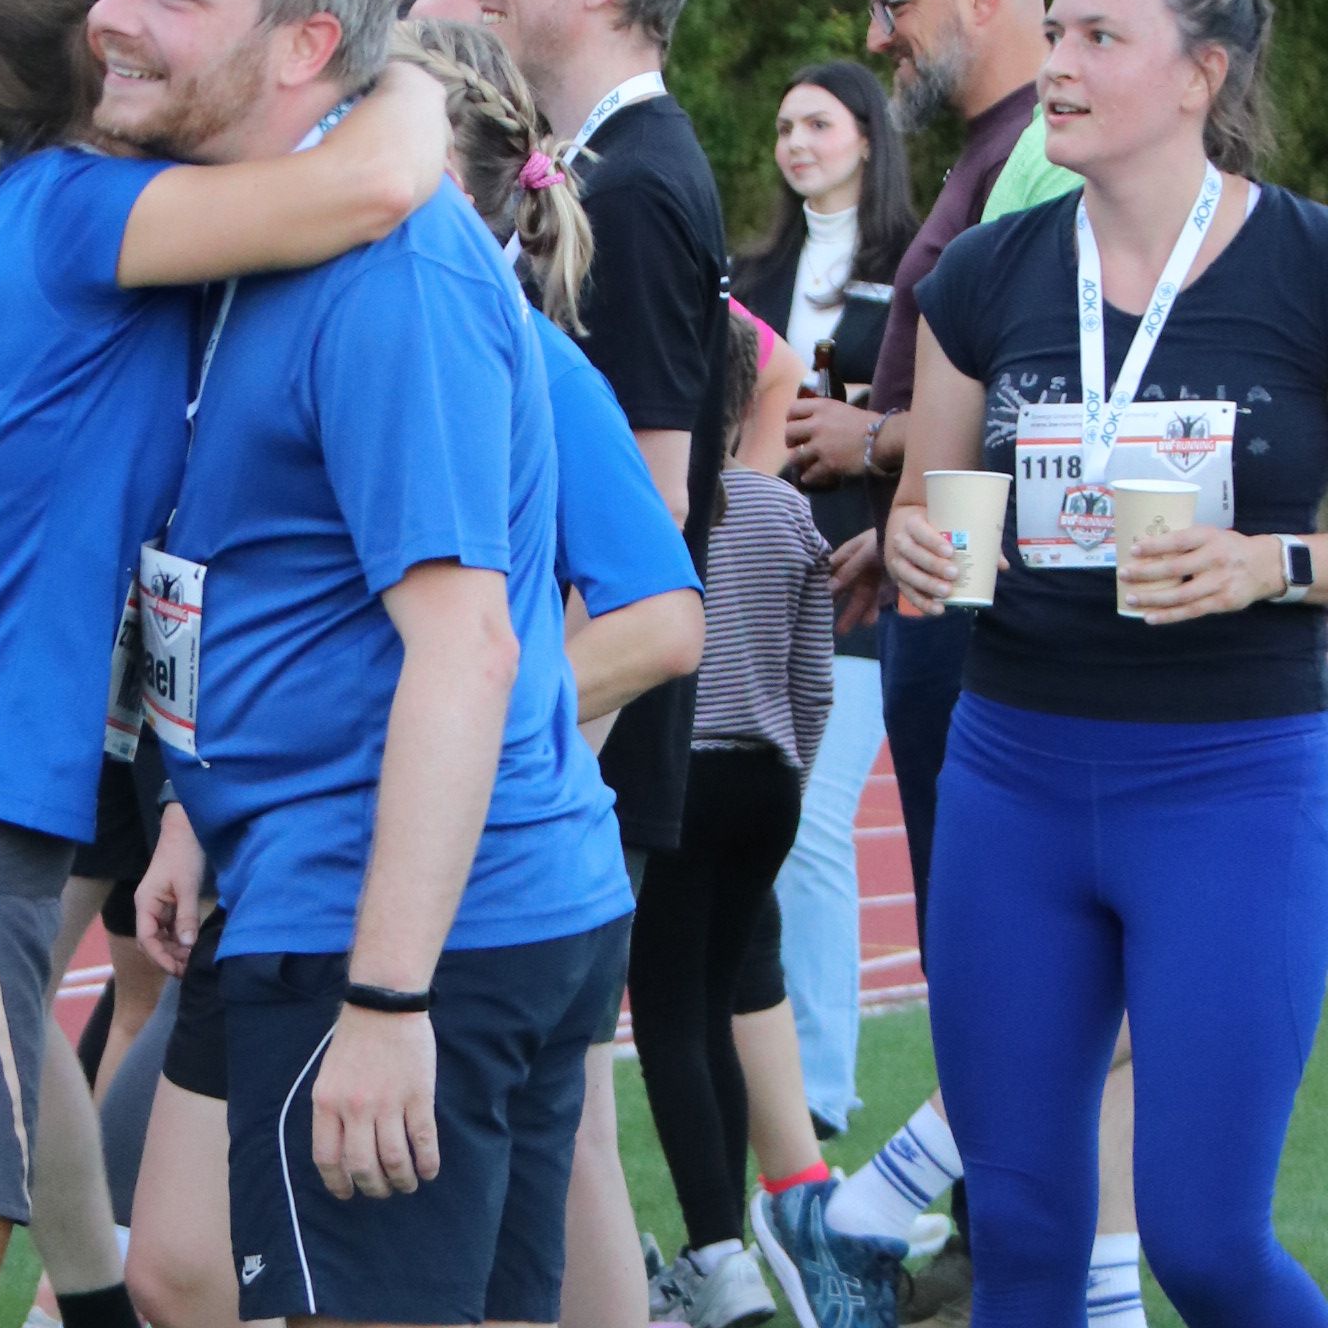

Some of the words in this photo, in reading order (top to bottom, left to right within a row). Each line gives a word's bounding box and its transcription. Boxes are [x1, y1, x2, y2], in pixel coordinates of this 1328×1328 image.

[591, 90, 620, 121] AOK
[1192, 198, 1216, 233] AOK
[1082, 278, 1098, 312] AOK
[1143, 301, 1167, 339] AOK
[998, 372, 1272, 403] AUSALIA
[1086, 388, 1101, 423] AOK
[1100, 411, 1123, 449] AOK
[1021, 455, 1082, 480] 1118
